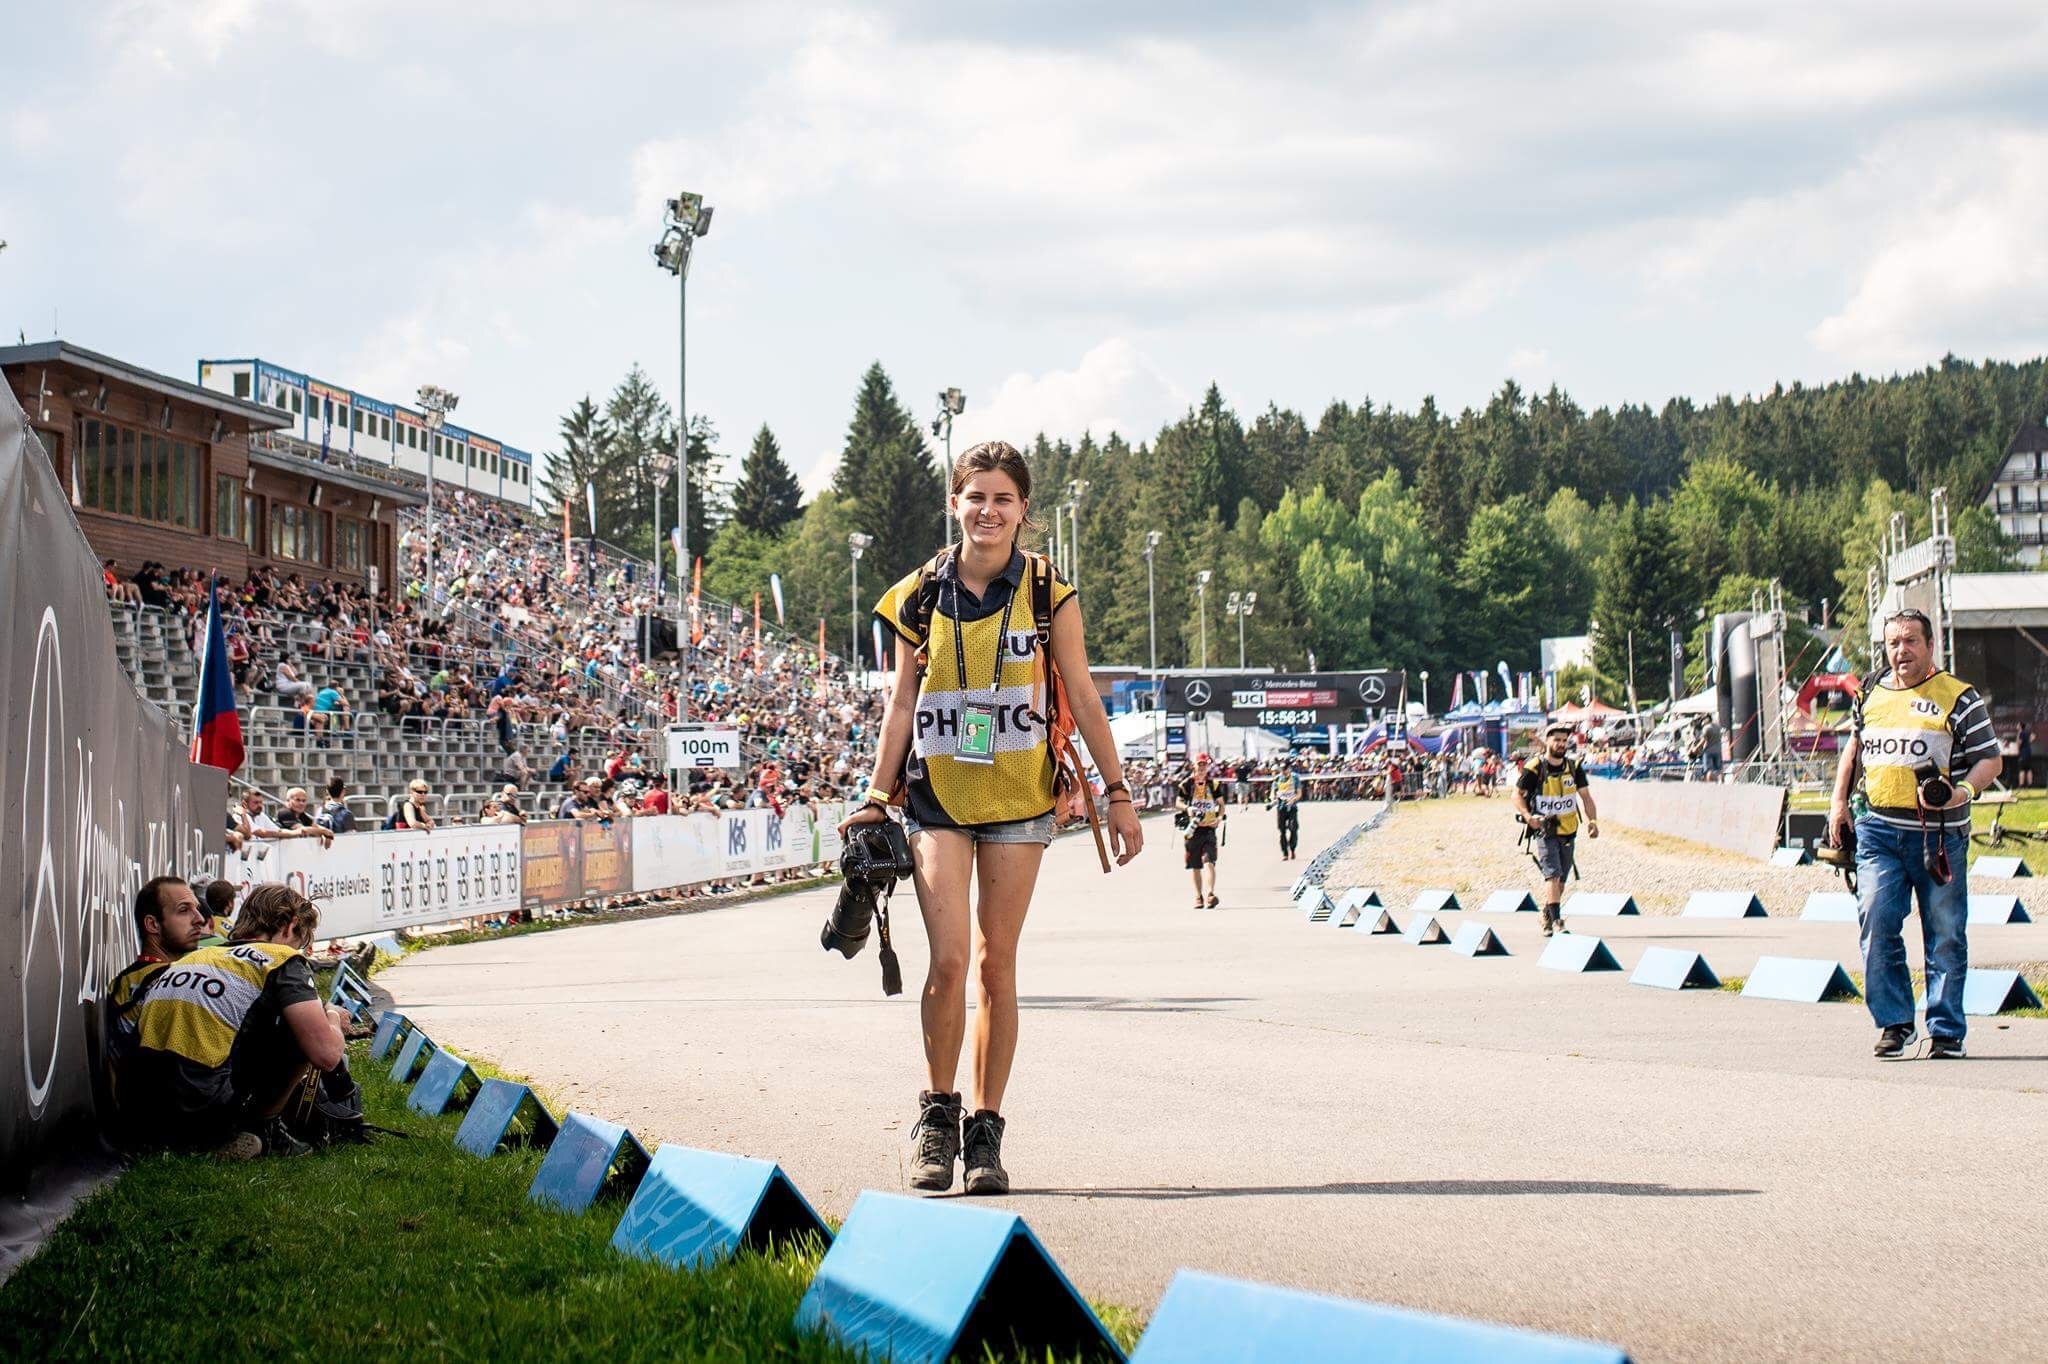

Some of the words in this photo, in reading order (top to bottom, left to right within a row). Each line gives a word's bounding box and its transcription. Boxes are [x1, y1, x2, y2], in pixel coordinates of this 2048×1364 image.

[1239, 694, 1263, 704] UCI
[1257, 710, 1317, 725] 15:56:31
[682, 740, 729, 754] 100m
[1541, 799, 1573, 810] PHOTO
[336, 874, 370, 897] televize
